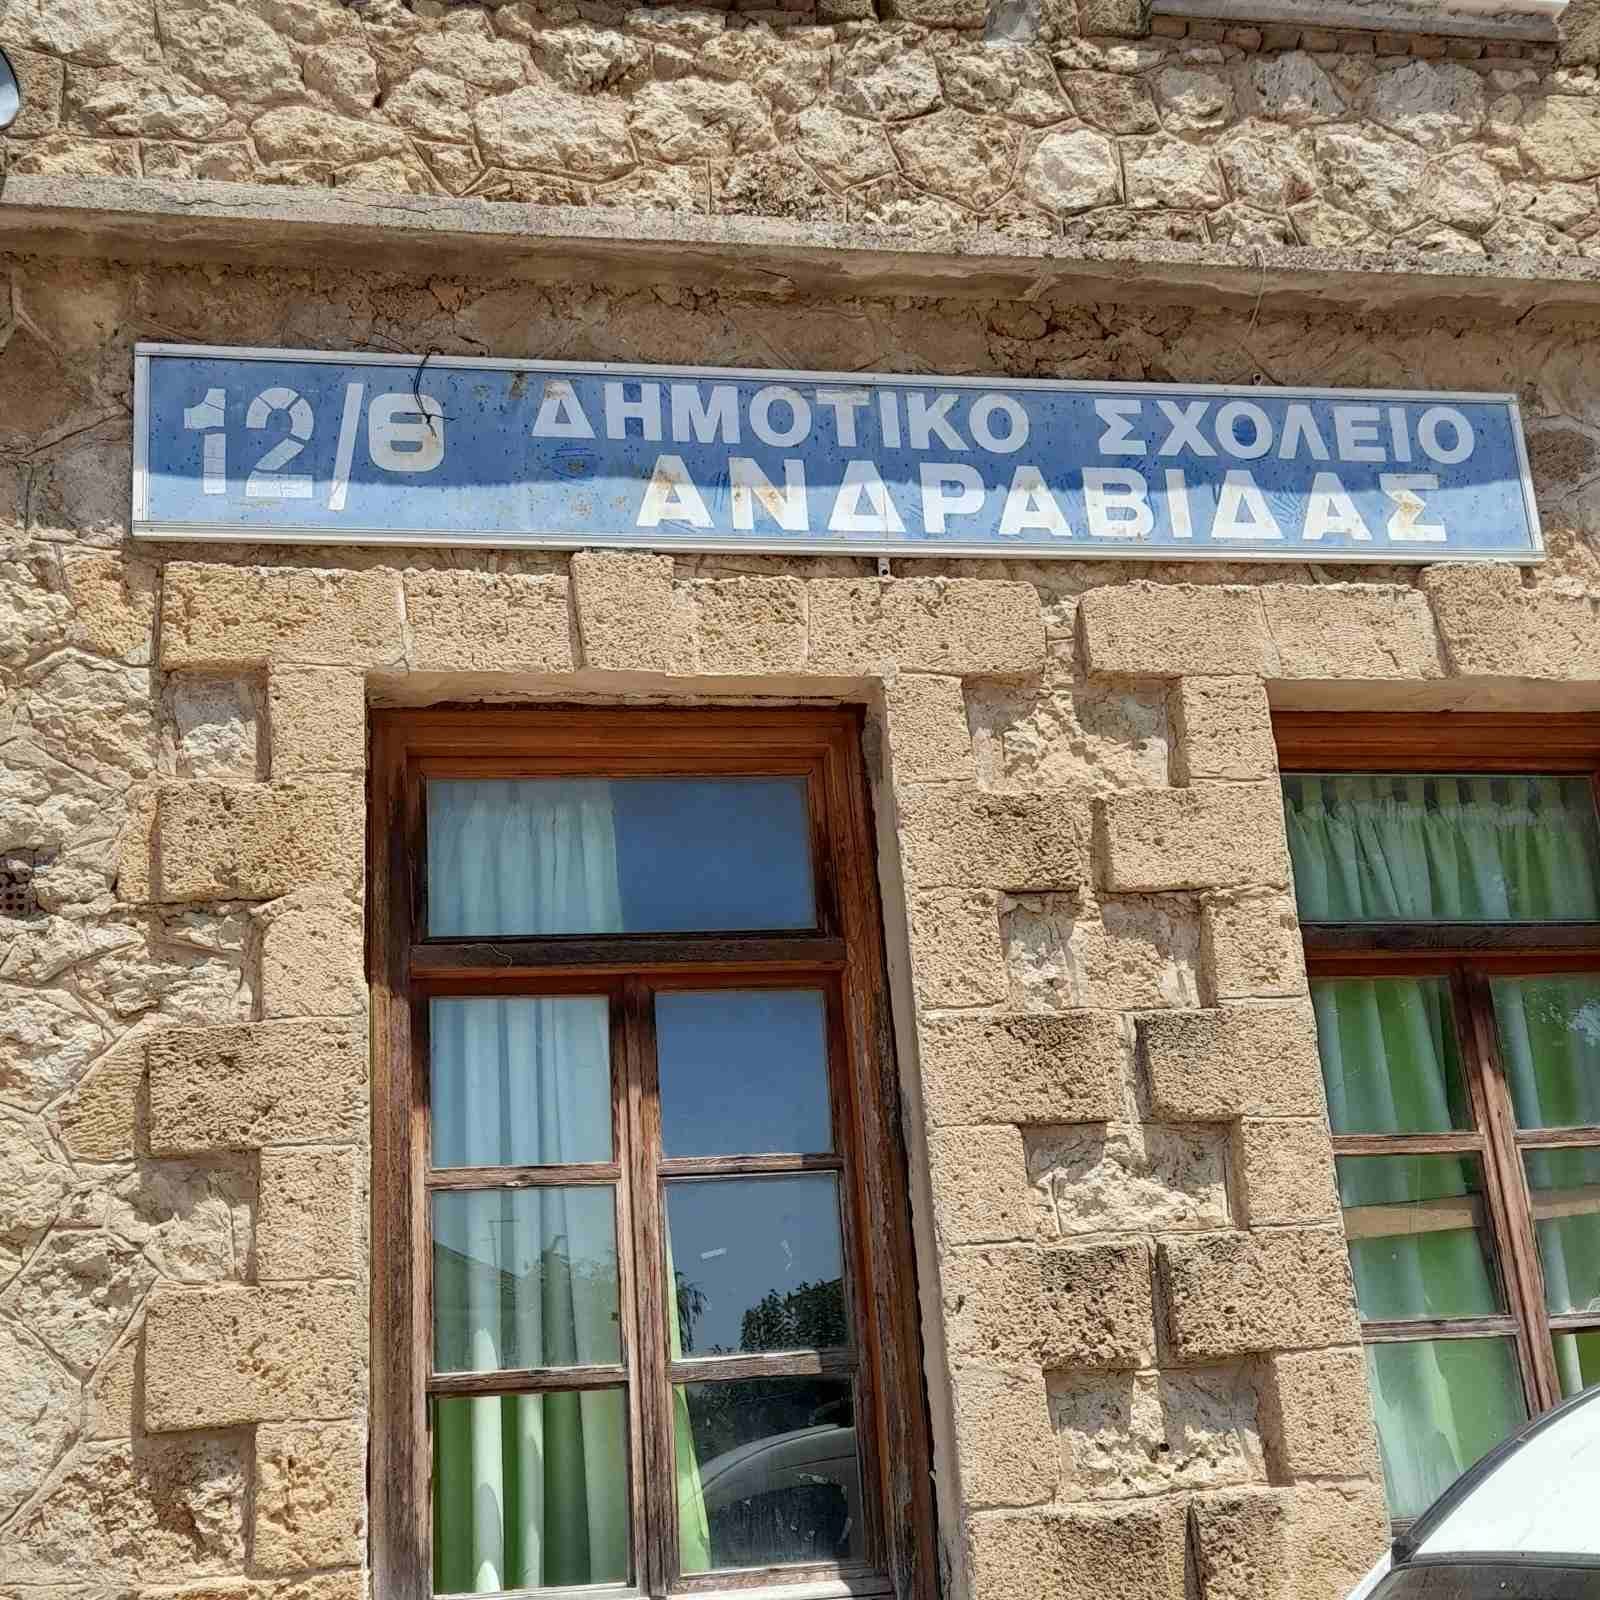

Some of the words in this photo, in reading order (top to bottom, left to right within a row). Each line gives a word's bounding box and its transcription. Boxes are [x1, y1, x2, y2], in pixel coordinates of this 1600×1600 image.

[531, 379, 1031, 454] ΔΗΜΟΤΙΚΟ
[1093, 398, 1476, 465] ΣΧΟΛΕΙΟ
[635, 454, 1448, 542] ΑΝΔΡΑΒΙΔΑΣ
